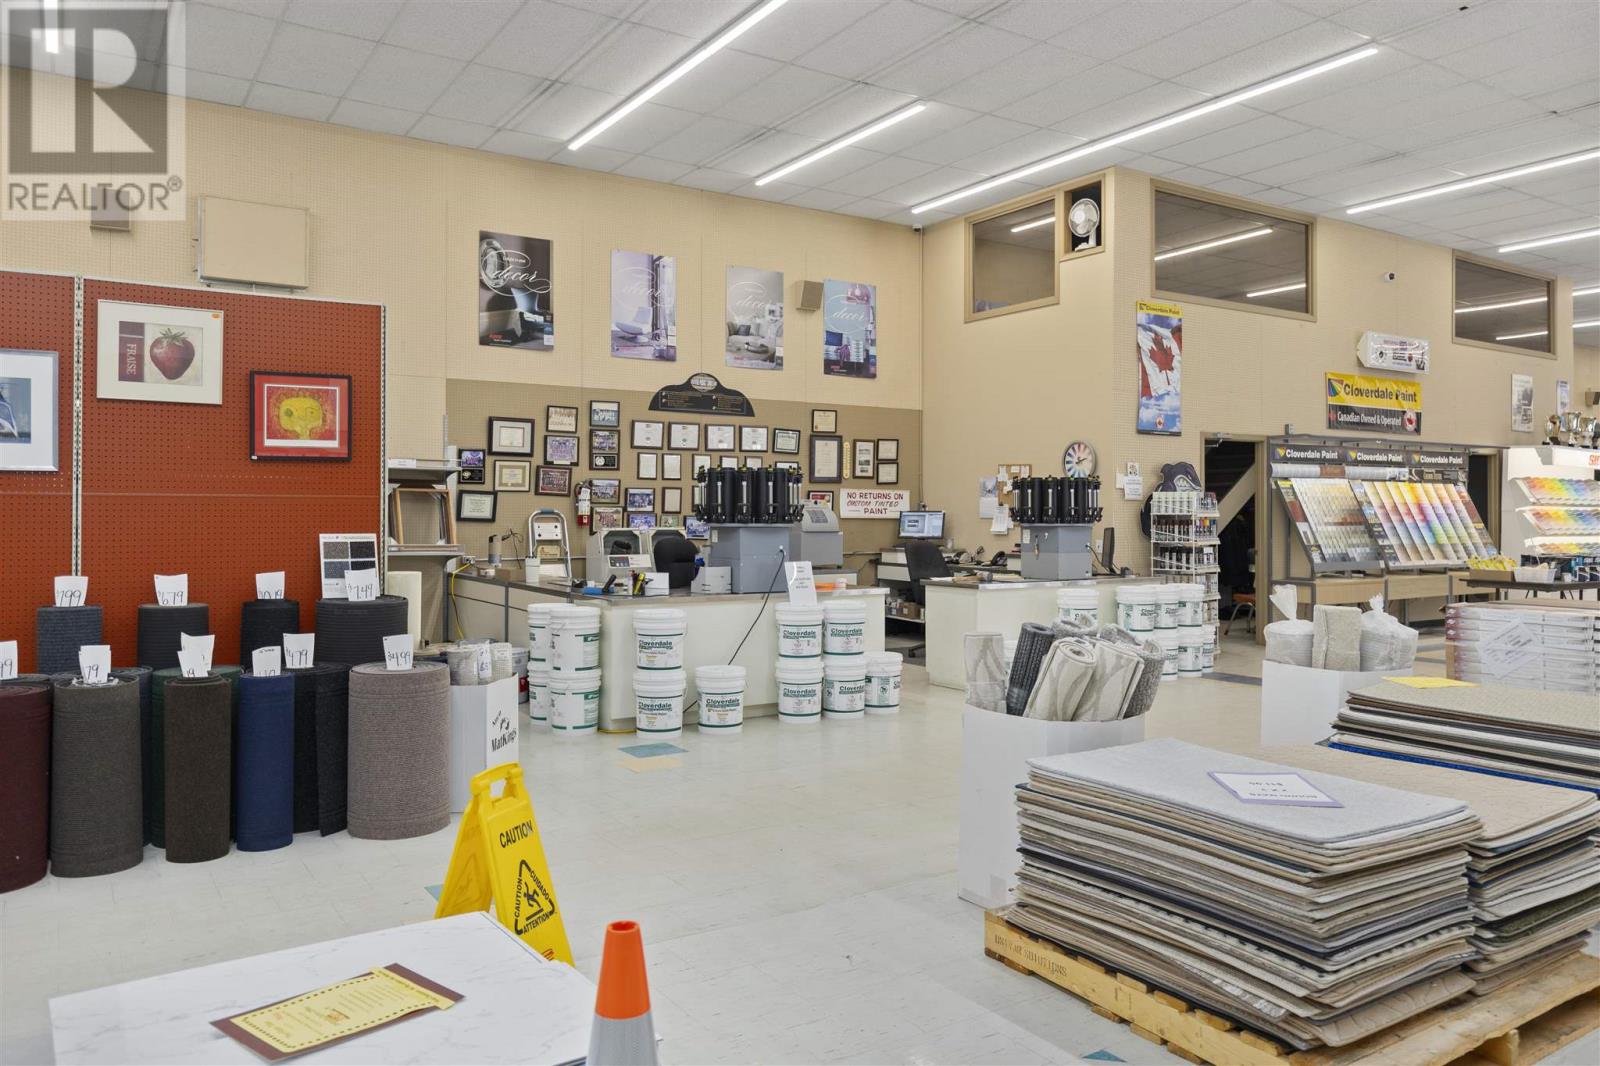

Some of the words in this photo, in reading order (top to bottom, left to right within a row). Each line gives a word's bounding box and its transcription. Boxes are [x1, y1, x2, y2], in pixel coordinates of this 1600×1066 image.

[126, 343, 137, 376] FRAISE
[1343, 383, 1393, 400] Cloverdale
[1395, 389, 1417, 403] Paint
[1337, 411, 1360, 423] Canadian
[1360, 413, 1376, 424] Owned
[1381, 416, 1402, 427] Operated
[1285, 448, 1320, 458] Cloverdale
[1321, 450, 1338, 459] Paint
[1356, 452, 1387, 461] Cloverdale
[1388, 453, 1403, 462] Paint
[1420, 455, 1449, 464] Cloverdale
[1449, 456, 1463, 464] Paint
[859, 492, 892, 500] RETURNS
[863, 507, 888, 515] PAINT
[499, 820, 534, 848] CAUTION
[529, 870, 550, 900] CUIDADO
[514, 876, 523, 918] CAUTION
[522, 911, 551, 934] ATTENTION
